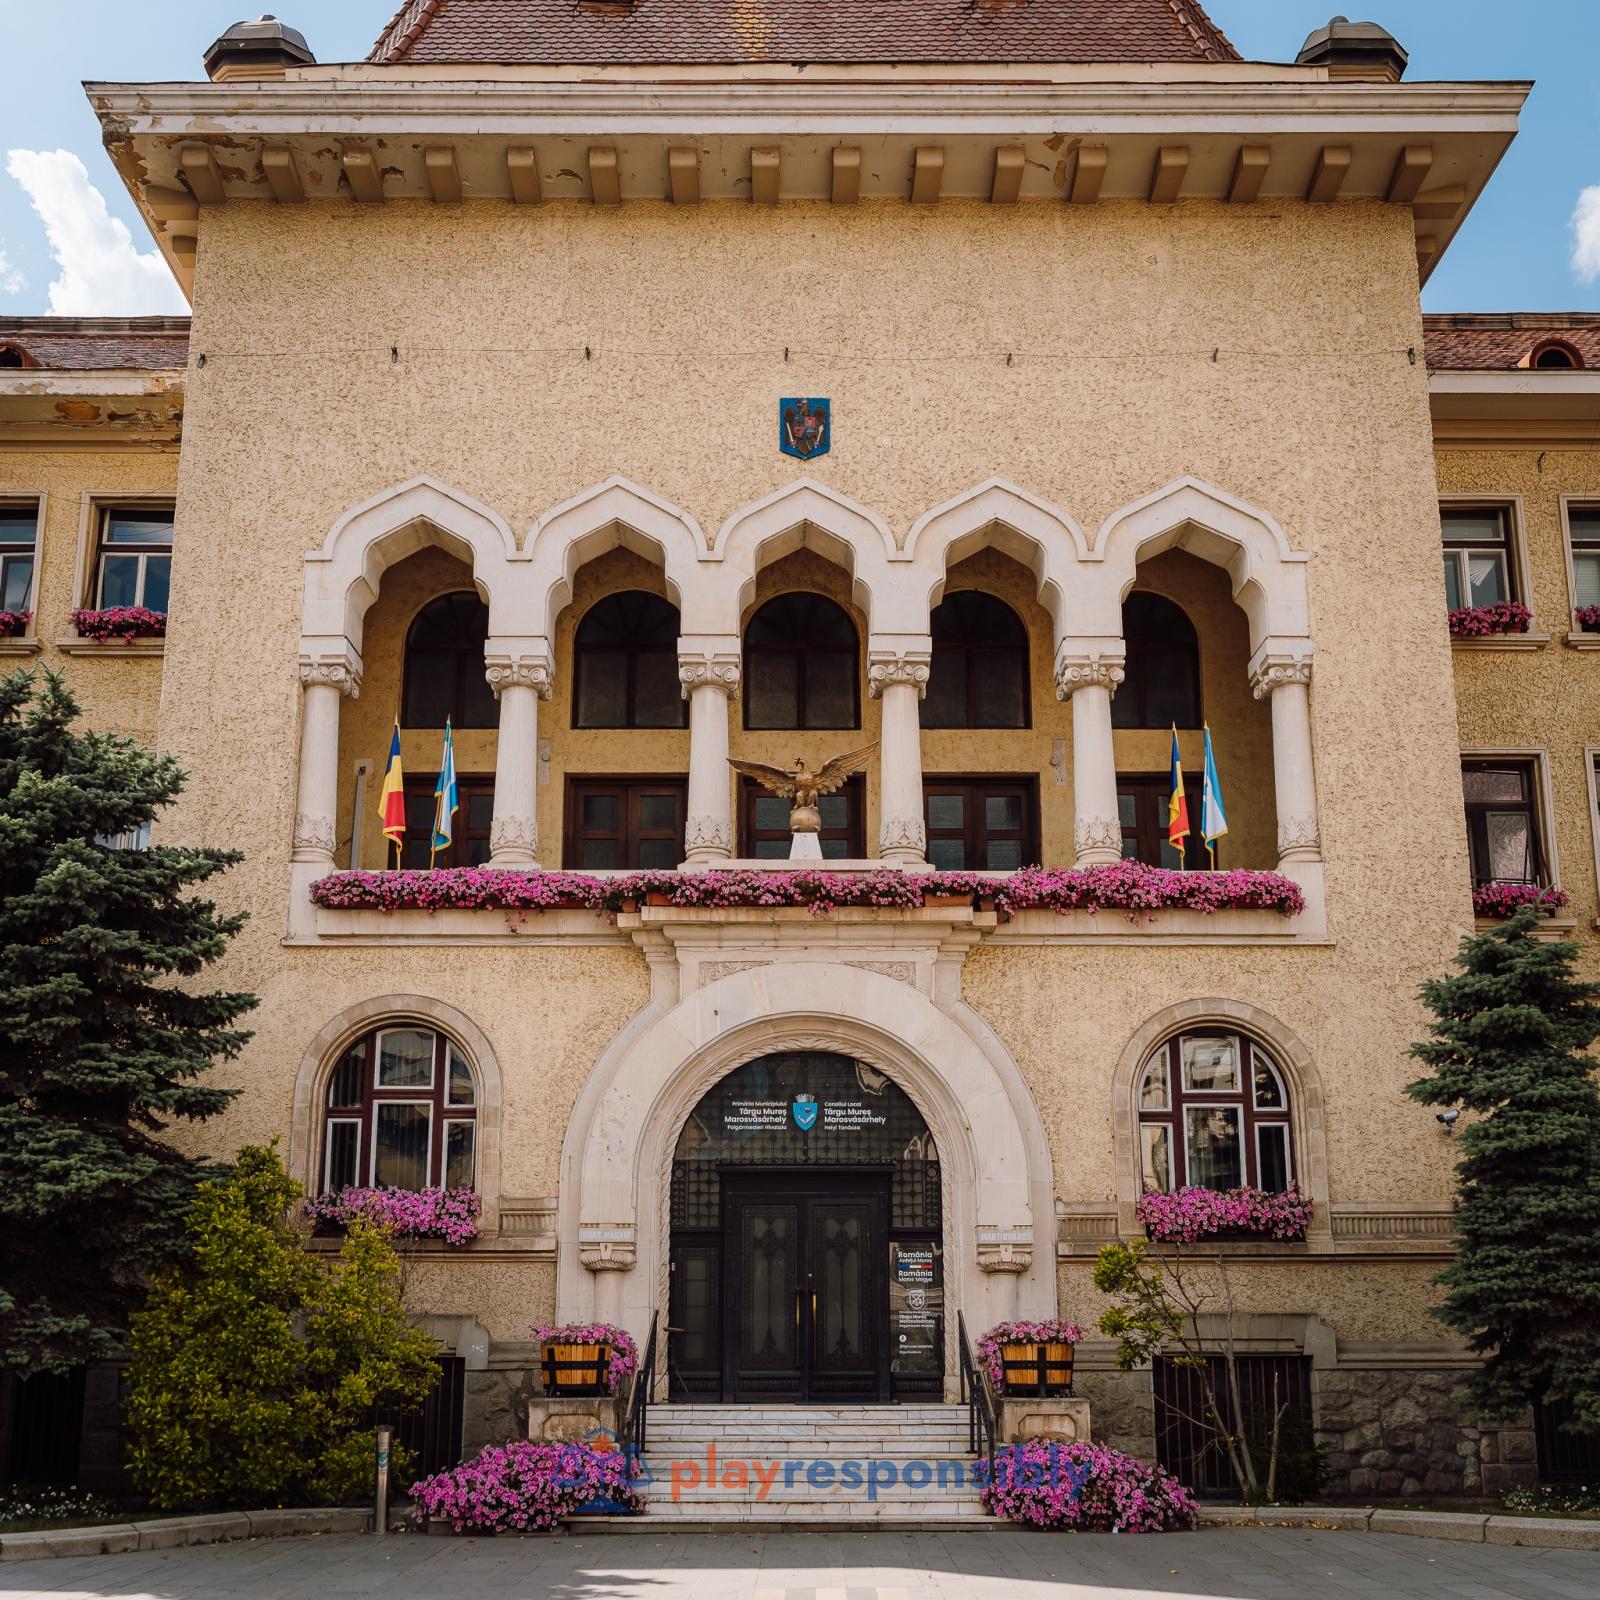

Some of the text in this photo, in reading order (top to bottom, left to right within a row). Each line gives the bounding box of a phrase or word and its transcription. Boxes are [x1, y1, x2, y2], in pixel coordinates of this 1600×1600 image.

[739, 1108, 761, 1116] Târgu
[824, 1108, 846, 1117] Târgu
[724, 1116, 787, 1125] Marosvásárhely
[824, 1116, 886, 1125] Marosvásárhely
[898, 1250, 933, 1258] România
